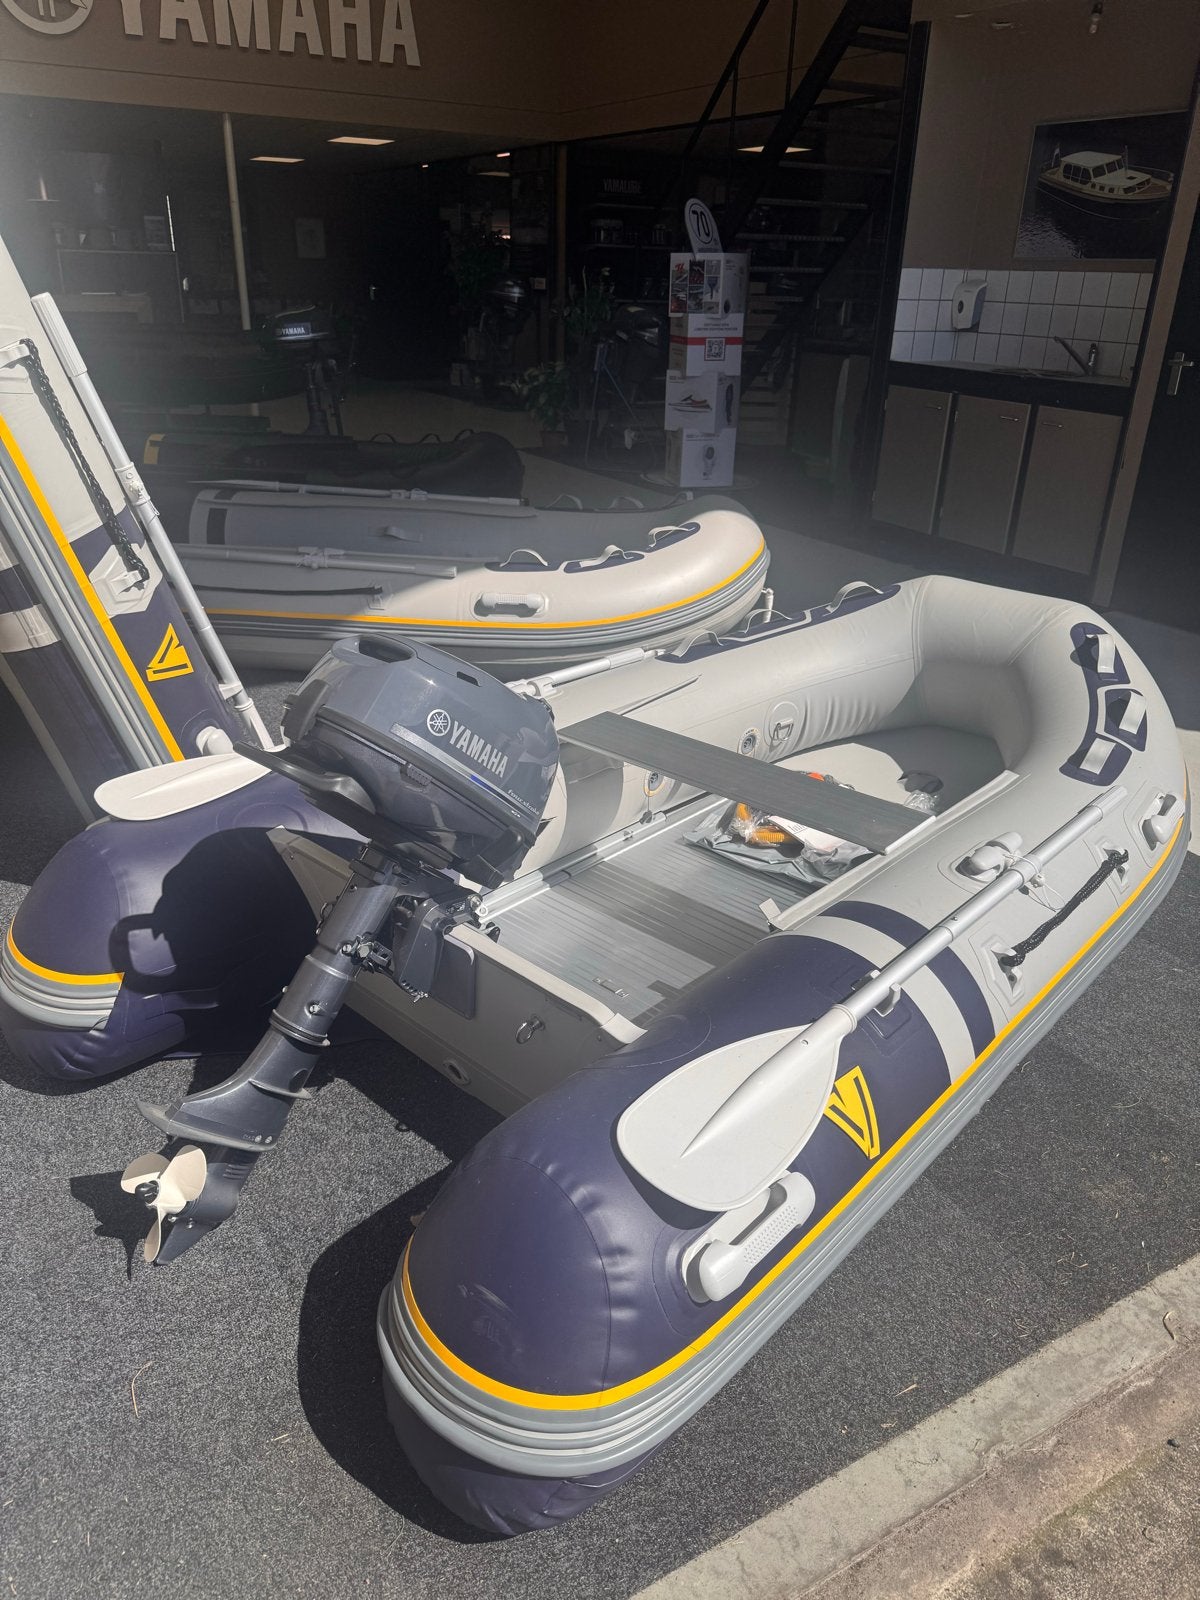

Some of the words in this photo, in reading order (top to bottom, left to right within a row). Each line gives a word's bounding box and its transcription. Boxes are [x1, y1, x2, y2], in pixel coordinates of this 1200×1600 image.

[691, 209, 711, 238] 70
[281, 327, 306, 335] YAMAHA
[449, 720, 509, 778] YAMAHA
